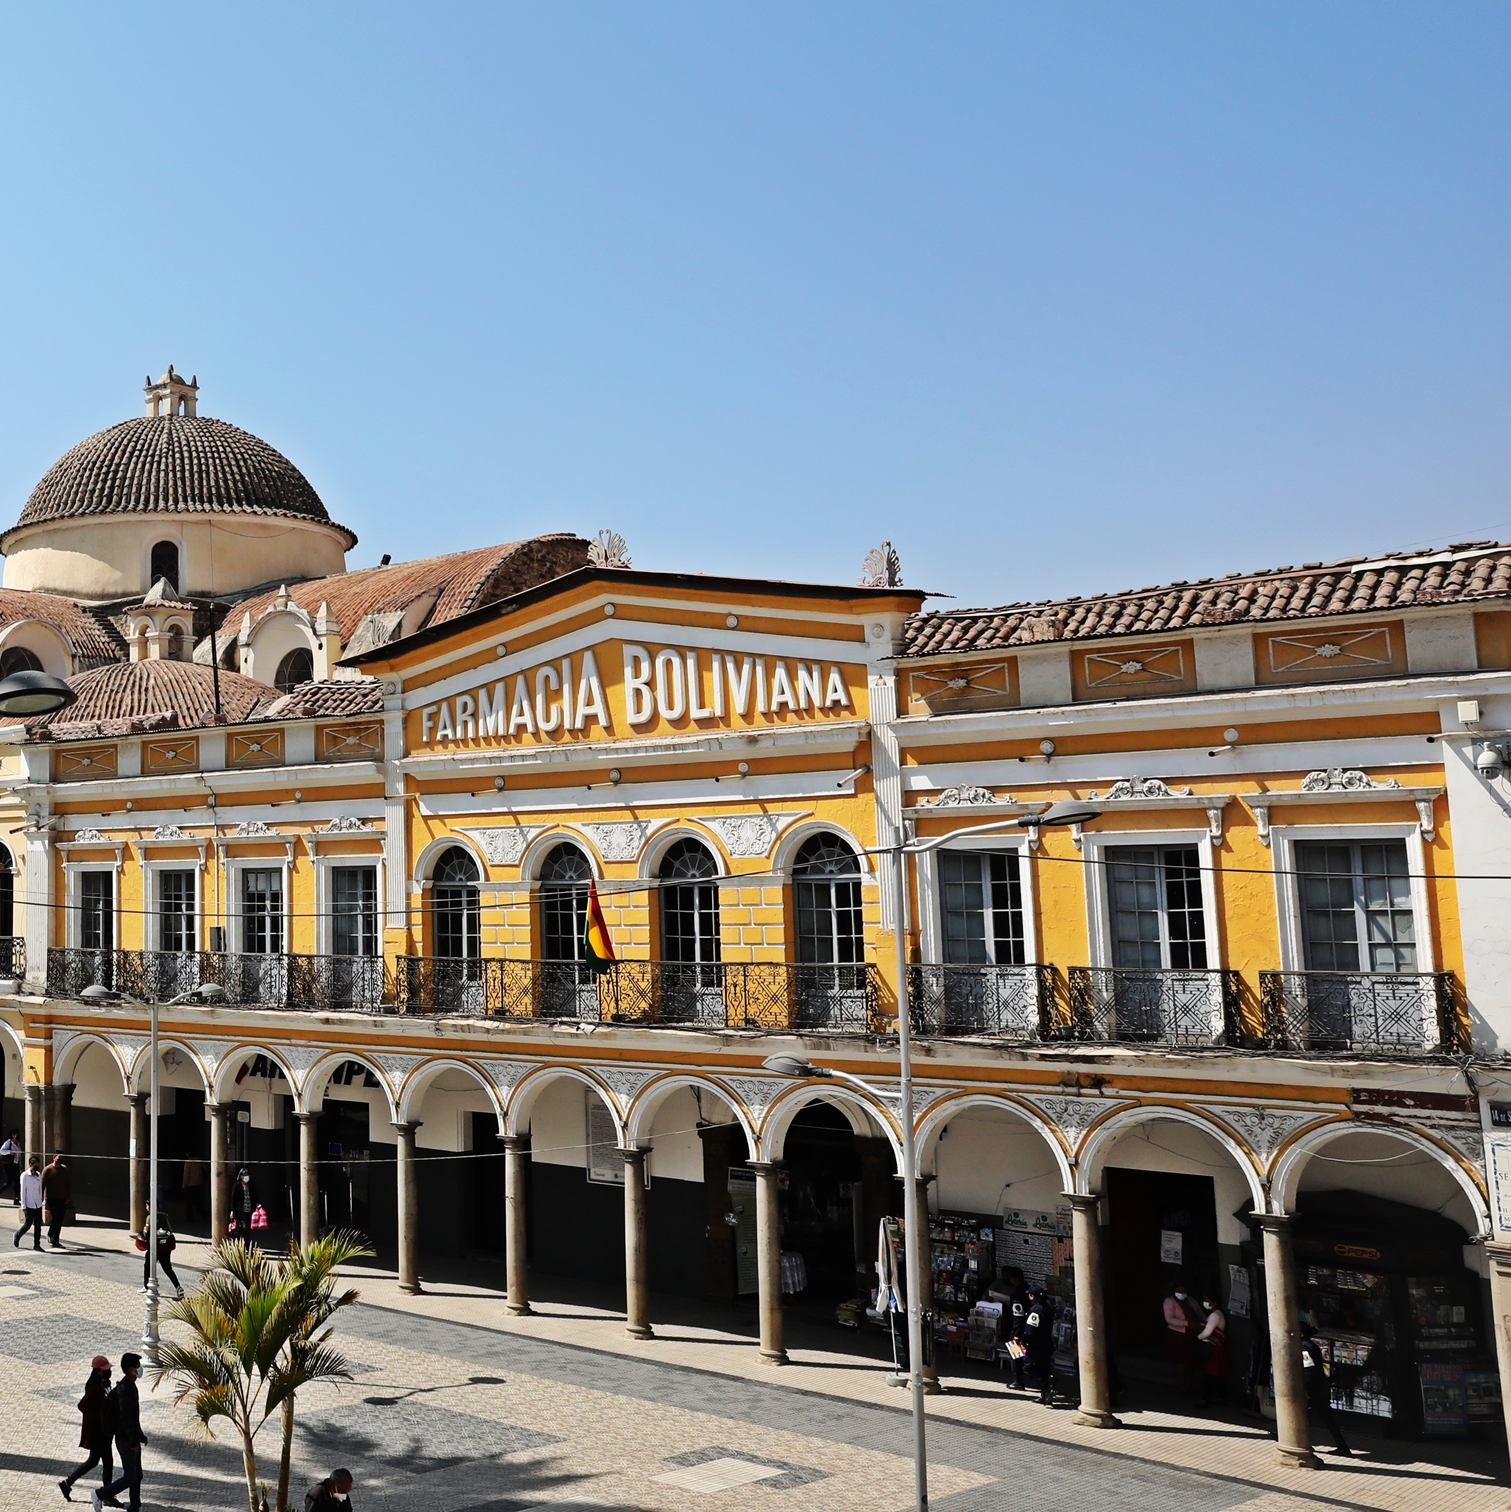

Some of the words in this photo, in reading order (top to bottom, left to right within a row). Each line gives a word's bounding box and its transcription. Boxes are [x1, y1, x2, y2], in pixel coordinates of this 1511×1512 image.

[422, 650, 611, 743] FARMACIA
[622, 644, 850, 726] BOLIVIANA
[1348, 1247, 1378, 1258] PEPSI
